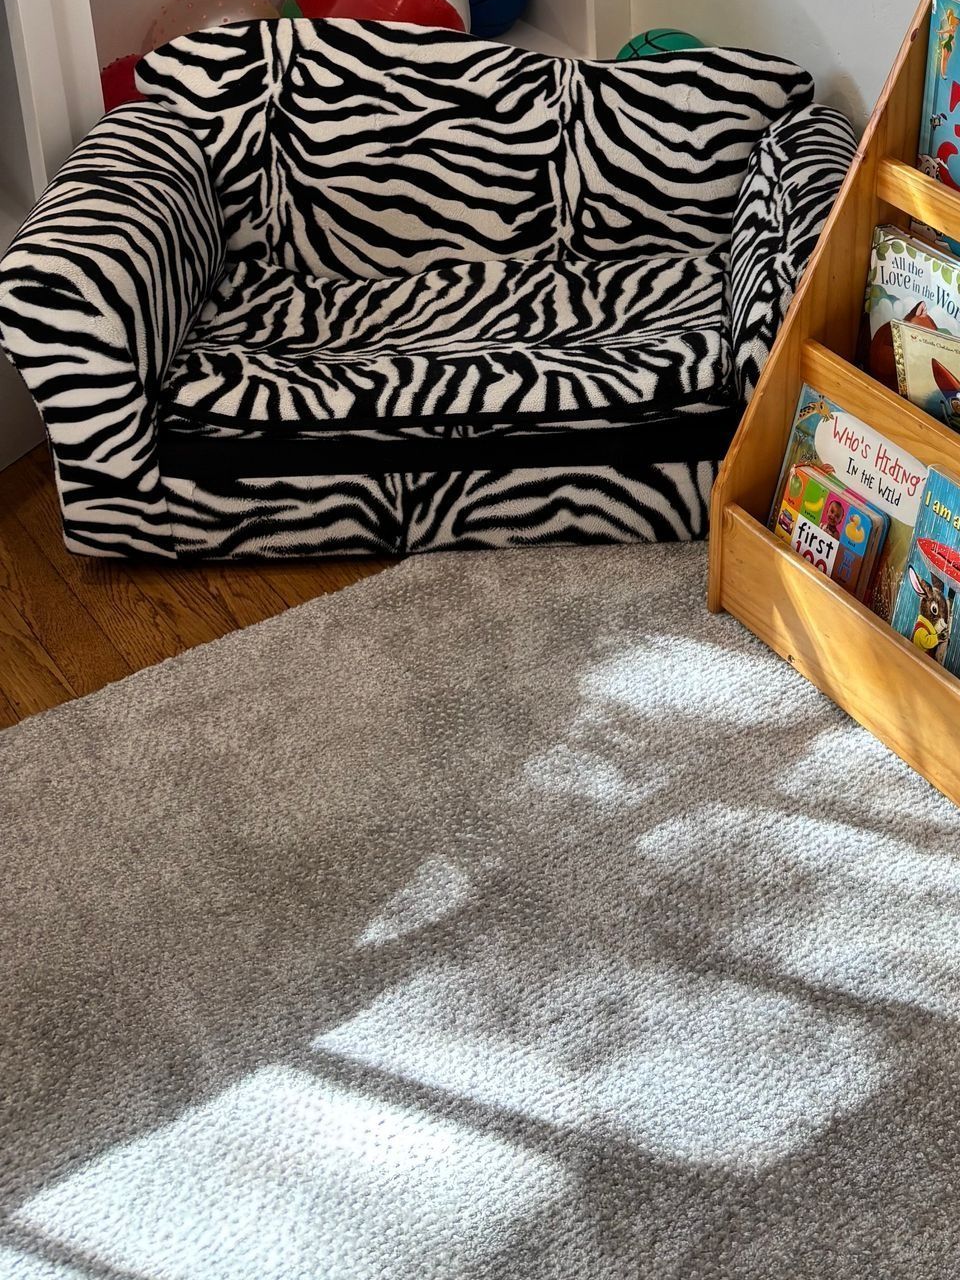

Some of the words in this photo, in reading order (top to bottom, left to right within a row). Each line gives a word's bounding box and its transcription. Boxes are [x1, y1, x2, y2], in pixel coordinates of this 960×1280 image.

[880, 265, 911, 289] Love
[912, 281, 921, 293] in
[922, 286, 935, 302] the
[892, 256, 906, 270] All
[907, 261, 924, 278] the
[832, 415, 872, 459] WHO'S
[925, 490, 934, 507] I
[932, 500, 952, 524] am
[798, 522, 834, 559] first
